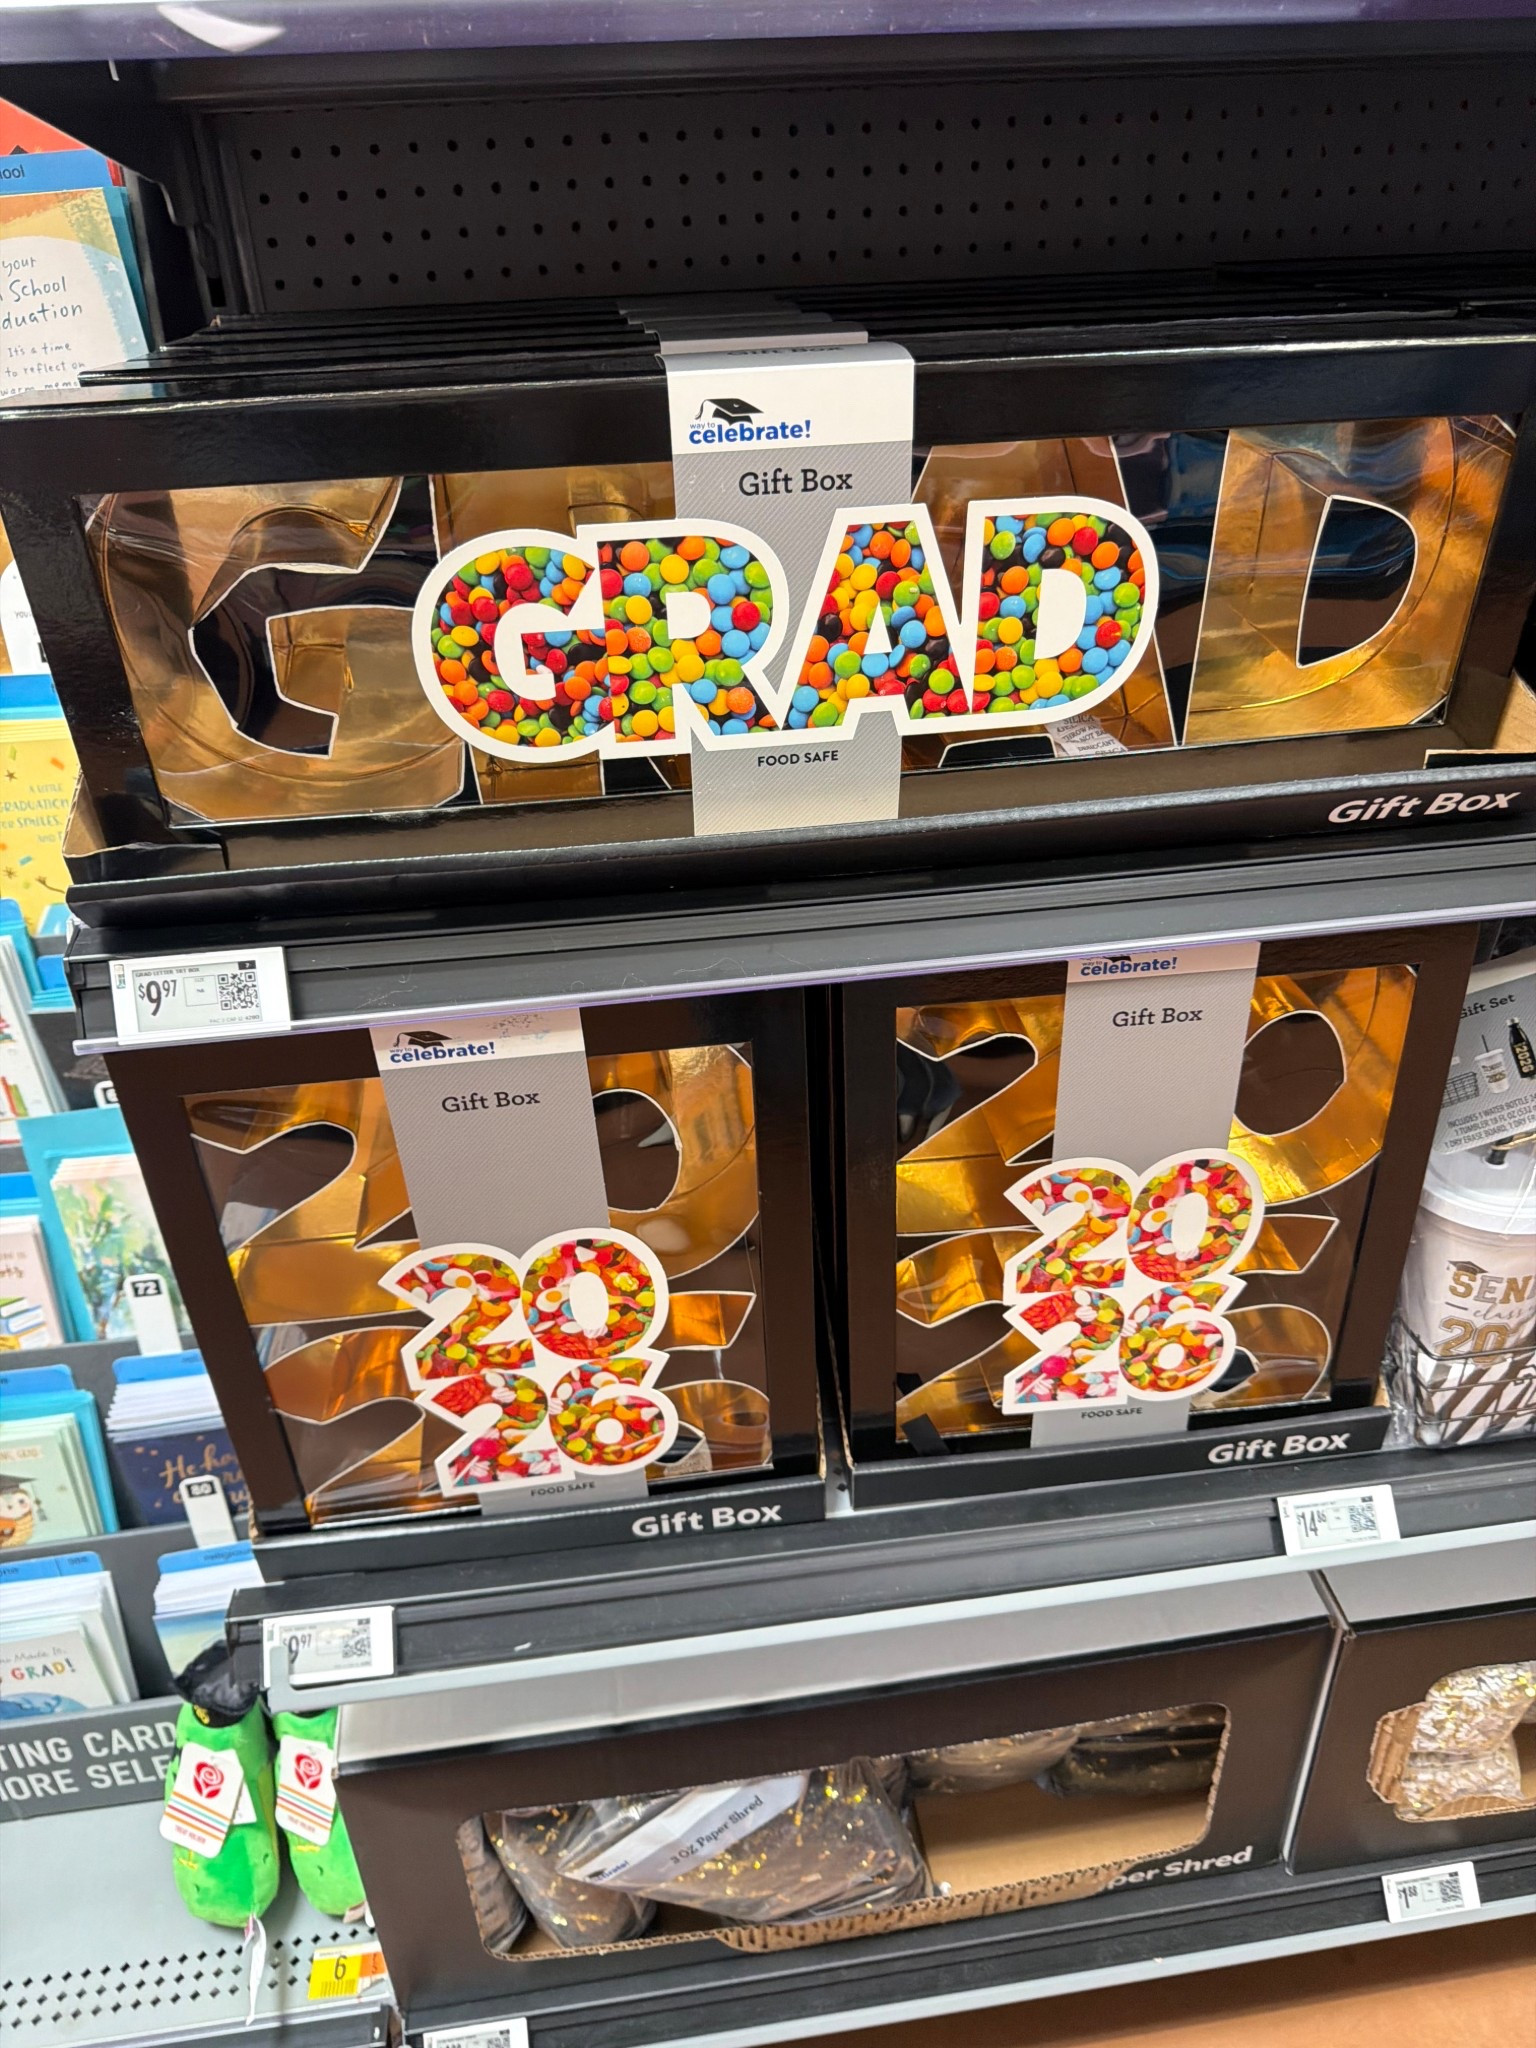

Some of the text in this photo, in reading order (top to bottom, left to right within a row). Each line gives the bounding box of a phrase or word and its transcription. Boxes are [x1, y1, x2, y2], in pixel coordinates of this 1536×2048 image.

[2, 257, 37, 277] your
[10, 276, 67, 302] School
[41, 342, 72, 354] time
[4, 360, 86, 378] to reflect on
[688, 419, 812, 445] celebrate!
[689, 420, 716, 431] way to
[738, 467, 853, 497] Gift Box
[418, 503, 1154, 756] GRAD
[757, 749, 840, 767] FOOD SAFE
[1327, 792, 1522, 824] Gift Box
[1080, 956, 1178, 977] celebrate!
[1488, 993, 1516, 1010] Set
[1112, 1007, 1204, 1028] Gift Box
[389, 1041, 496, 1064] celebrate!
[441, 1090, 541, 1113] Gift Box
[1010, 1153, 1259, 1298] 20
[134, 1281, 158, 1295] 72
[387, 1231, 662, 1384] 20
[1008, 1278, 1236, 1409] 26
[424, 1354, 671, 1491] 26
[1080, 1407, 1143, 1419] FOOD SAFE
[1207, 1432, 1351, 1465] Gift Box
[530, 1481, 597, 1497] FOOD SAFE
[631, 1504, 783, 1538] Gift Box
[11, 1656, 76, 1681] GRAD!
[82, 1721, 177, 1758] CARD
[678, 1843, 699, 1859] OZ
[696, 1821, 732, 1849] Paper
[728, 1793, 765, 1825] Shred
[1162, 1845, 1254, 1878] Shred
